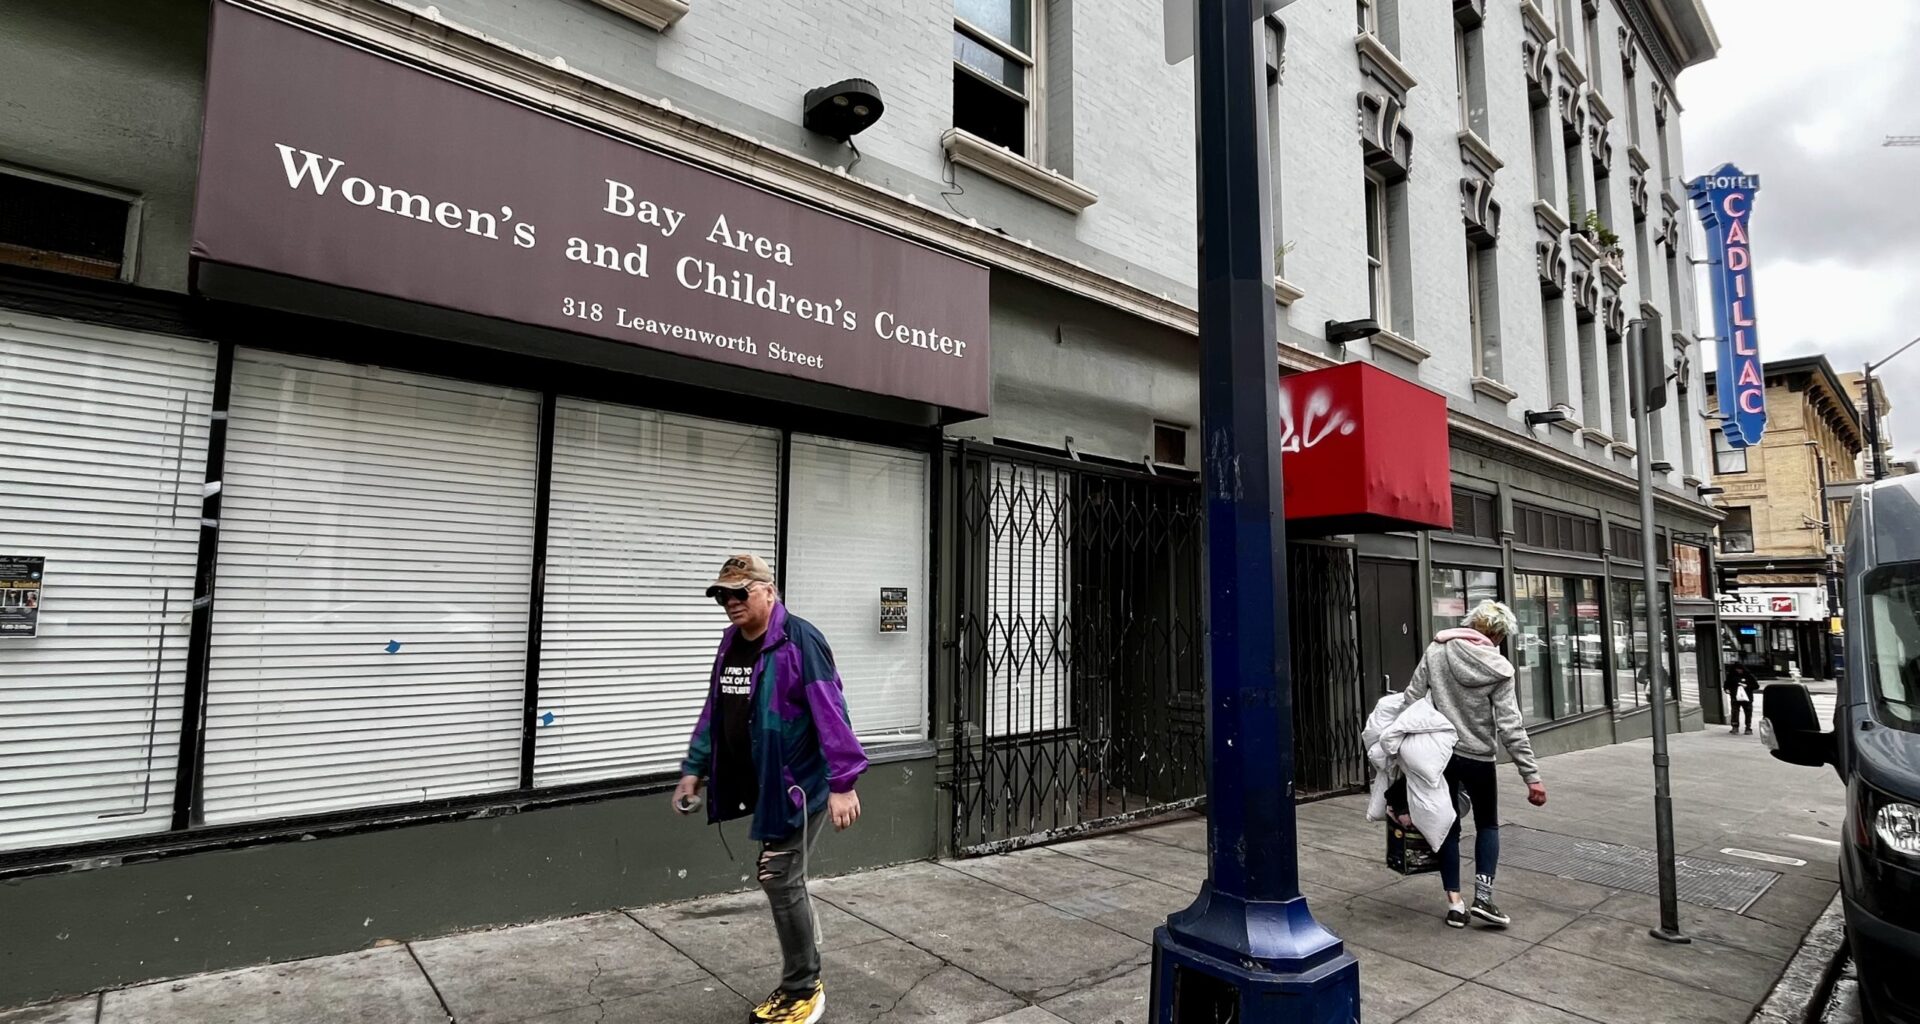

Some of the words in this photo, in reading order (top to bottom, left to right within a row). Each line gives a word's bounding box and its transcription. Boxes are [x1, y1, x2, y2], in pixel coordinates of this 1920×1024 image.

[1705, 176, 1755, 190] HOTEL
[274, 142, 537, 249] Women's
[565, 236, 649, 278] and
[676, 255, 857, 331] Children's
[874, 310, 968, 359] Center
[603, 178, 686, 237] Bay
[705, 213, 795, 267] Area
[562, 296, 604, 323] 318
[616, 307, 759, 356] Leavenworth
[768, 341, 825, 370] Street
[1723, 193, 1763, 414] CADILLAC
[1720, 605, 1765, 613] RKET
[743, 667, 753, 675] YO
